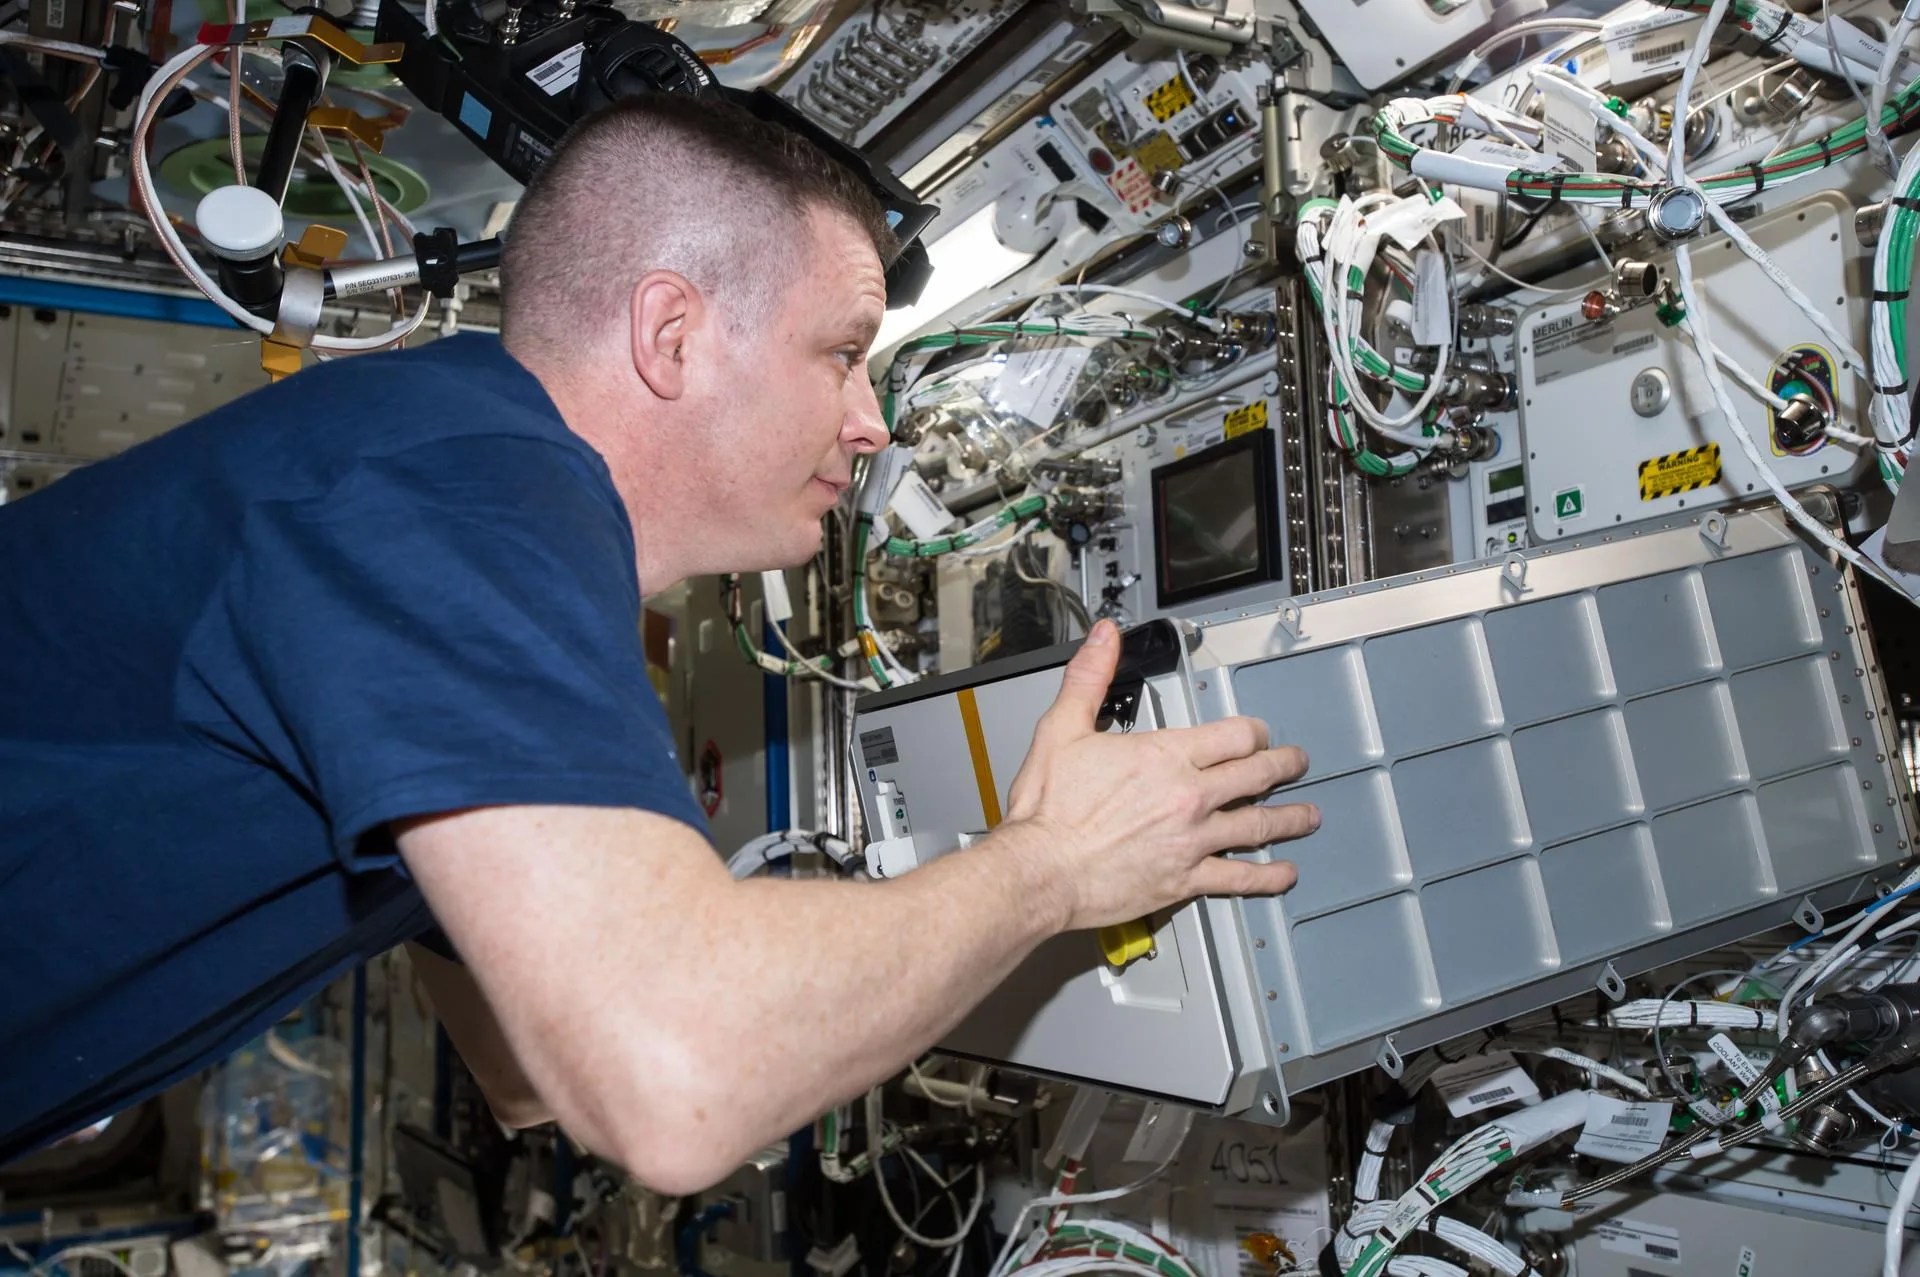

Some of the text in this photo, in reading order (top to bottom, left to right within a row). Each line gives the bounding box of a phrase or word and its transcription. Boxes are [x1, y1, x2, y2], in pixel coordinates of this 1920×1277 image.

[1533, 316, 1573, 339] MERLIN
[1658, 455, 1700, 471] WARNING
[1713, 1041, 1740, 1071] COOLANT
[1210, 1140, 1289, 1185] 4051
